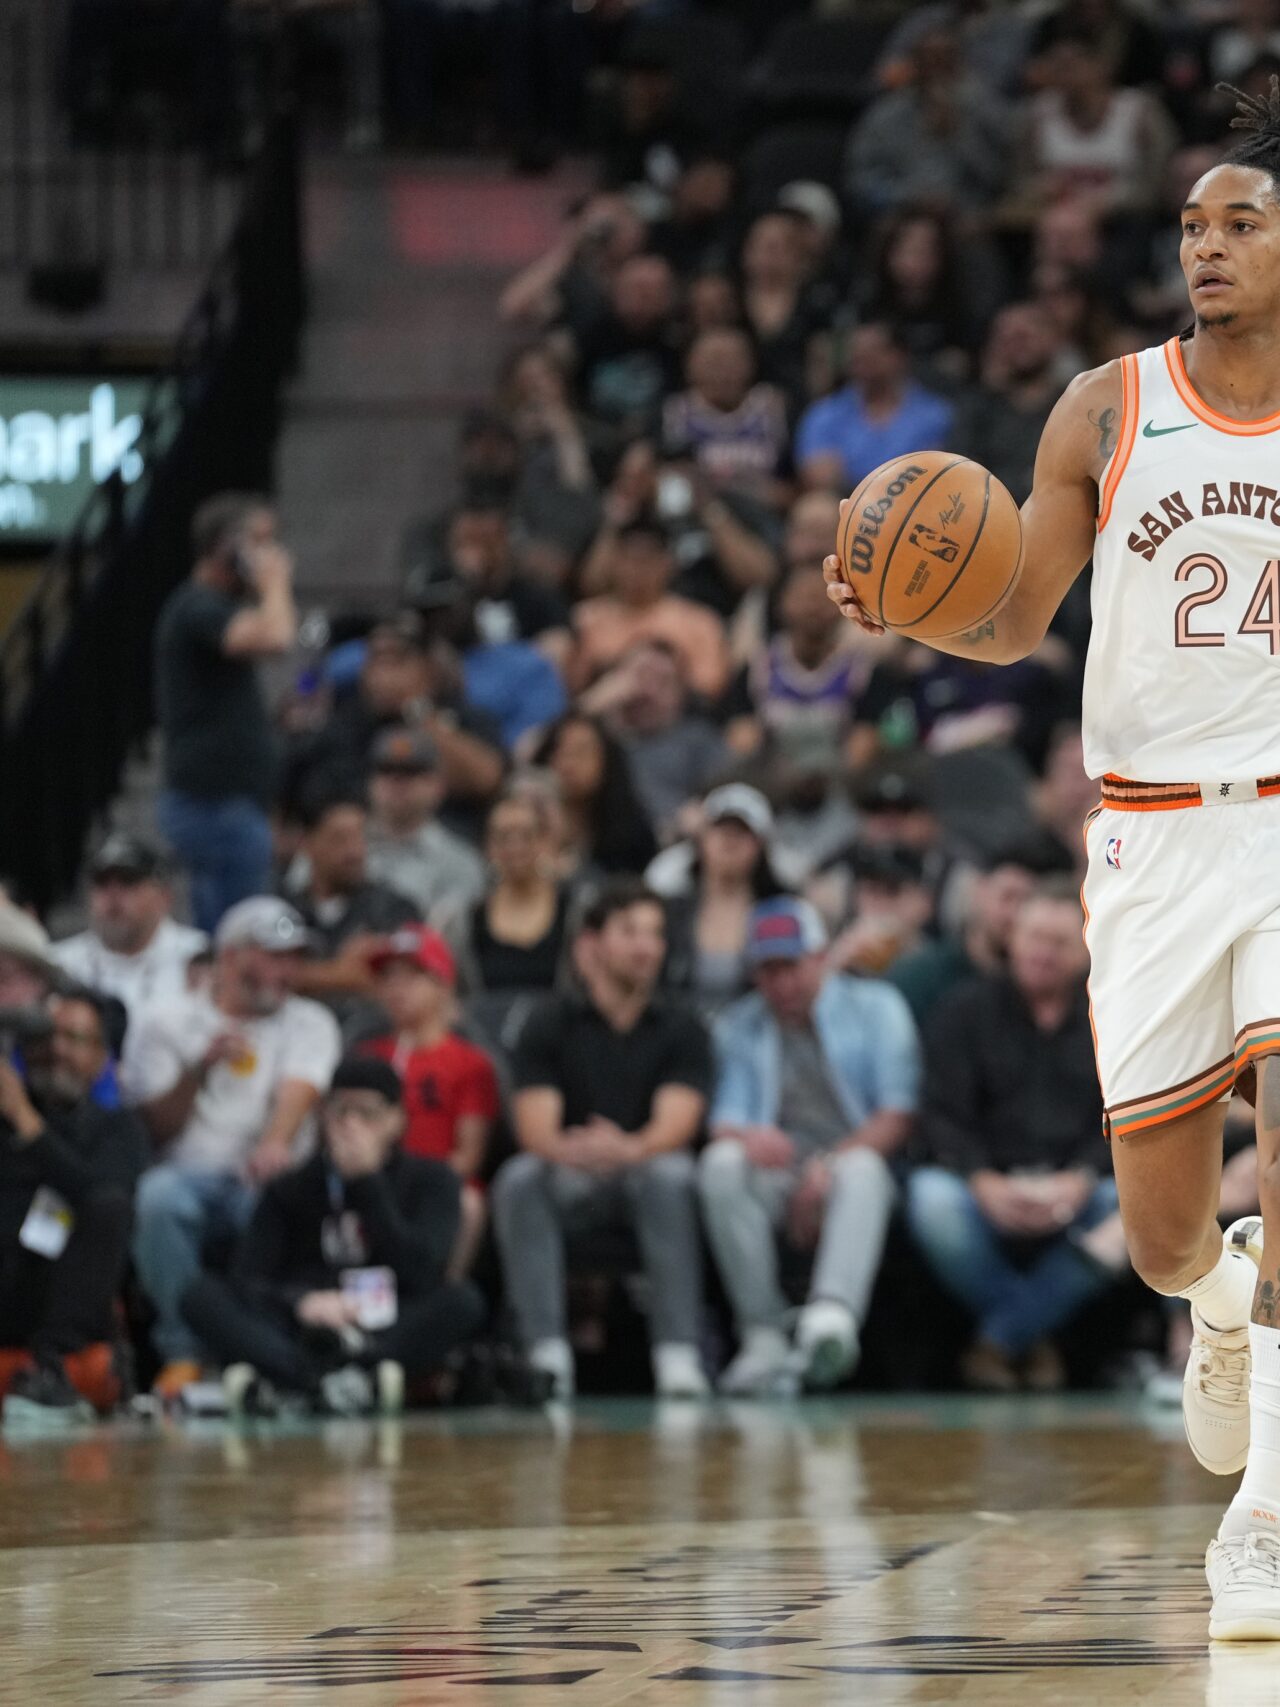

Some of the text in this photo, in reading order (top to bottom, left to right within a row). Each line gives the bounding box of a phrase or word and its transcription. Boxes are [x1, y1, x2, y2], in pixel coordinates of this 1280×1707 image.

[0, 382, 144, 485] ark.
[851, 465, 929, 574] Wilson
[1127, 490, 1194, 562] SAN
